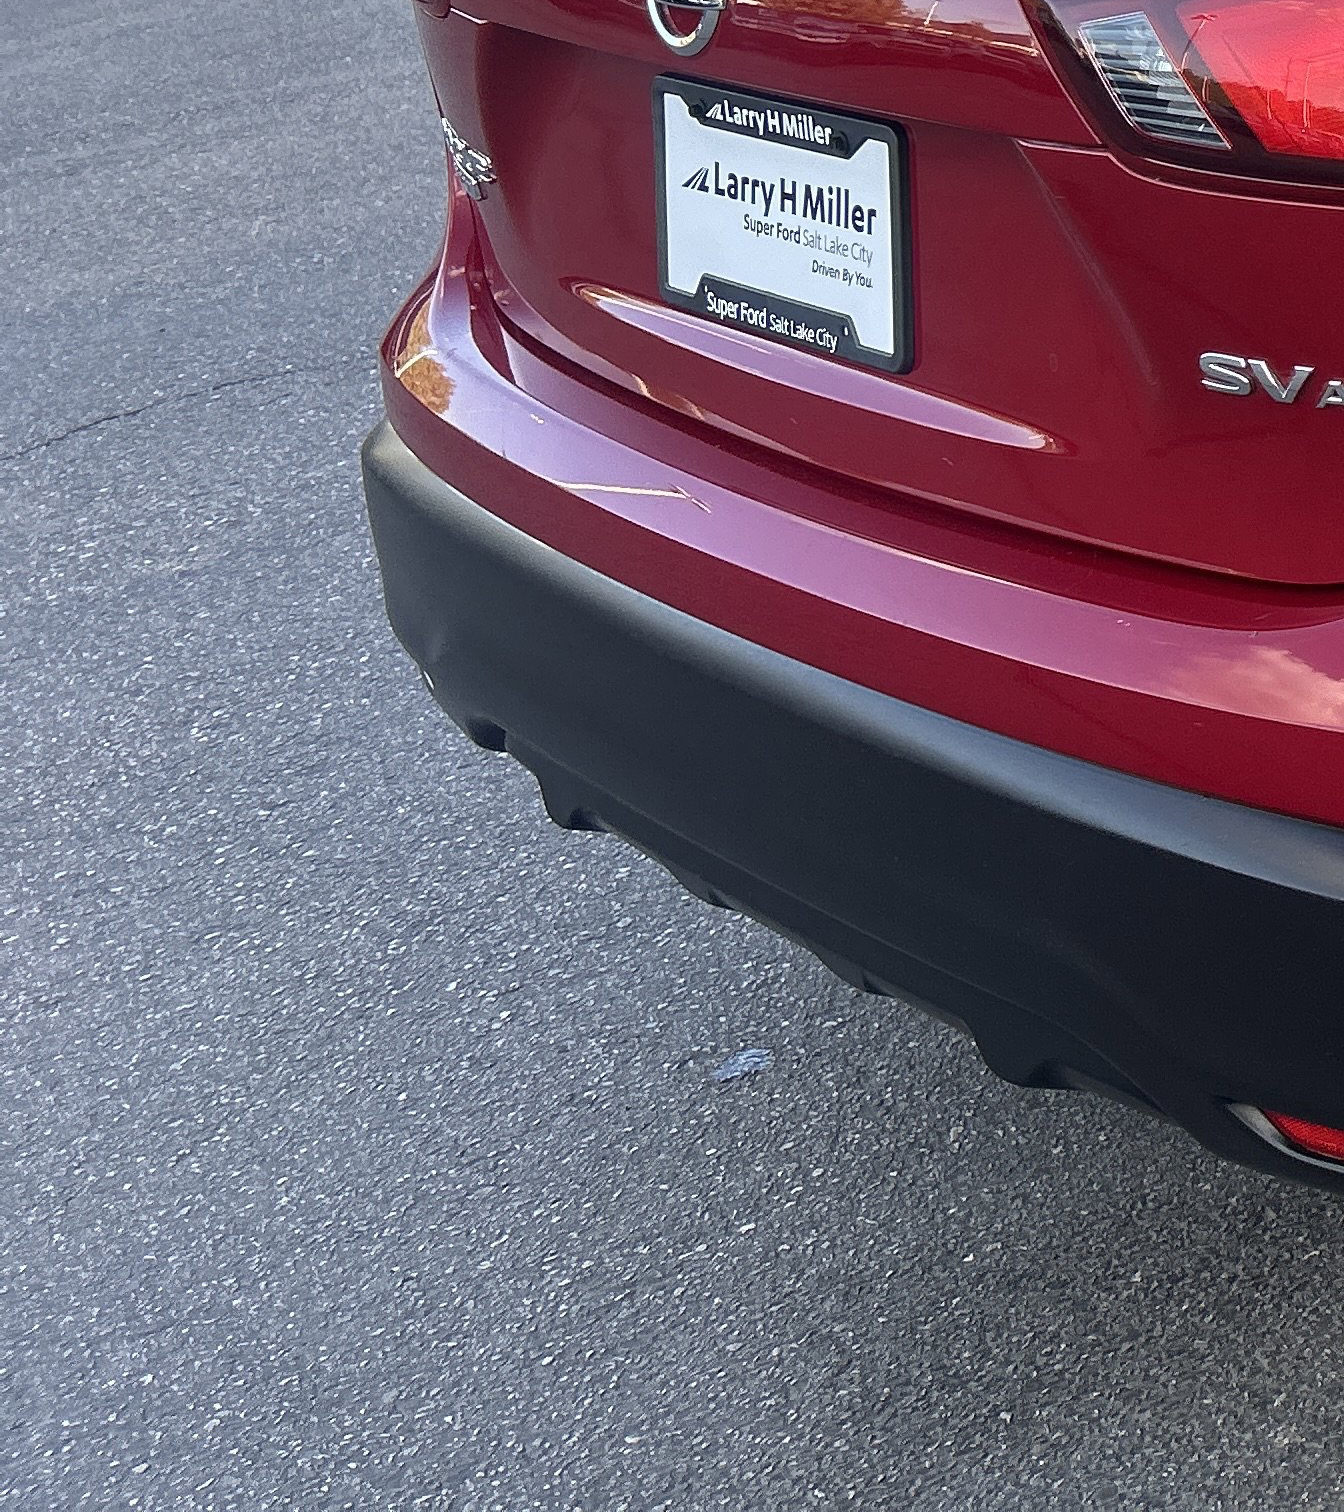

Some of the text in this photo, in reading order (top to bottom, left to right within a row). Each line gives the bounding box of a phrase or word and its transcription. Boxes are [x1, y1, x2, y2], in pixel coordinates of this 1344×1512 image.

[724, 99, 832, 145] Larry H Miller
[714, 161, 877, 235] Larry H Miller
[743, 213, 873, 268] Super Ford Salt Lake City
[811, 259, 841, 279] Driven
[842, 268, 855, 287] By
[706, 291, 838, 354] Super Ford Salt Lake City
[1199, 351, 1315, 404] SV
